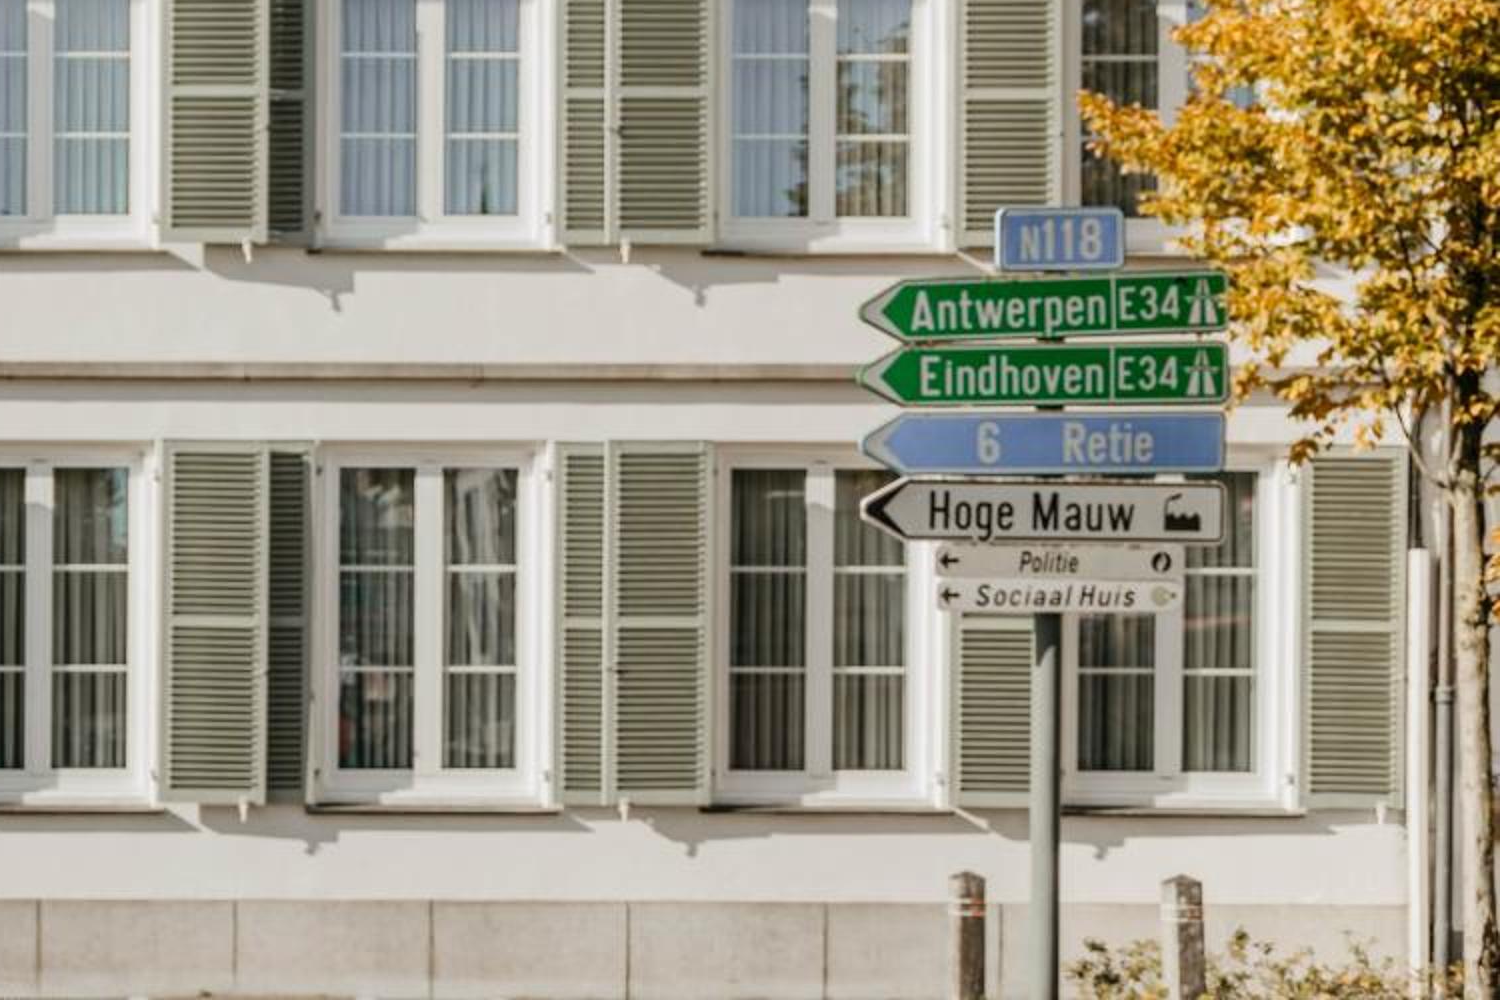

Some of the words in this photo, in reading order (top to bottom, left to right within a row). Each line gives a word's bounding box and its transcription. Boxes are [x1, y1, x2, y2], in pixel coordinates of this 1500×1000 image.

[1019, 217, 1103, 262] N118
[910, 290, 1108, 336] Antwerpen
[1118, 285, 1181, 321] E34
[919, 355, 1103, 397] Eindhoven
[1117, 356, 1179, 391] E34
[977, 422, 1001, 465] 6
[1062, 422, 1155, 464] Retie
[929, 490, 1014, 541] Hoge
[1031, 492, 1136, 532] Mauw
[1018, 551, 1079, 574] Politie
[975, 584, 1071, 608] Sociaal
[1079, 585, 1137, 607] Huis
